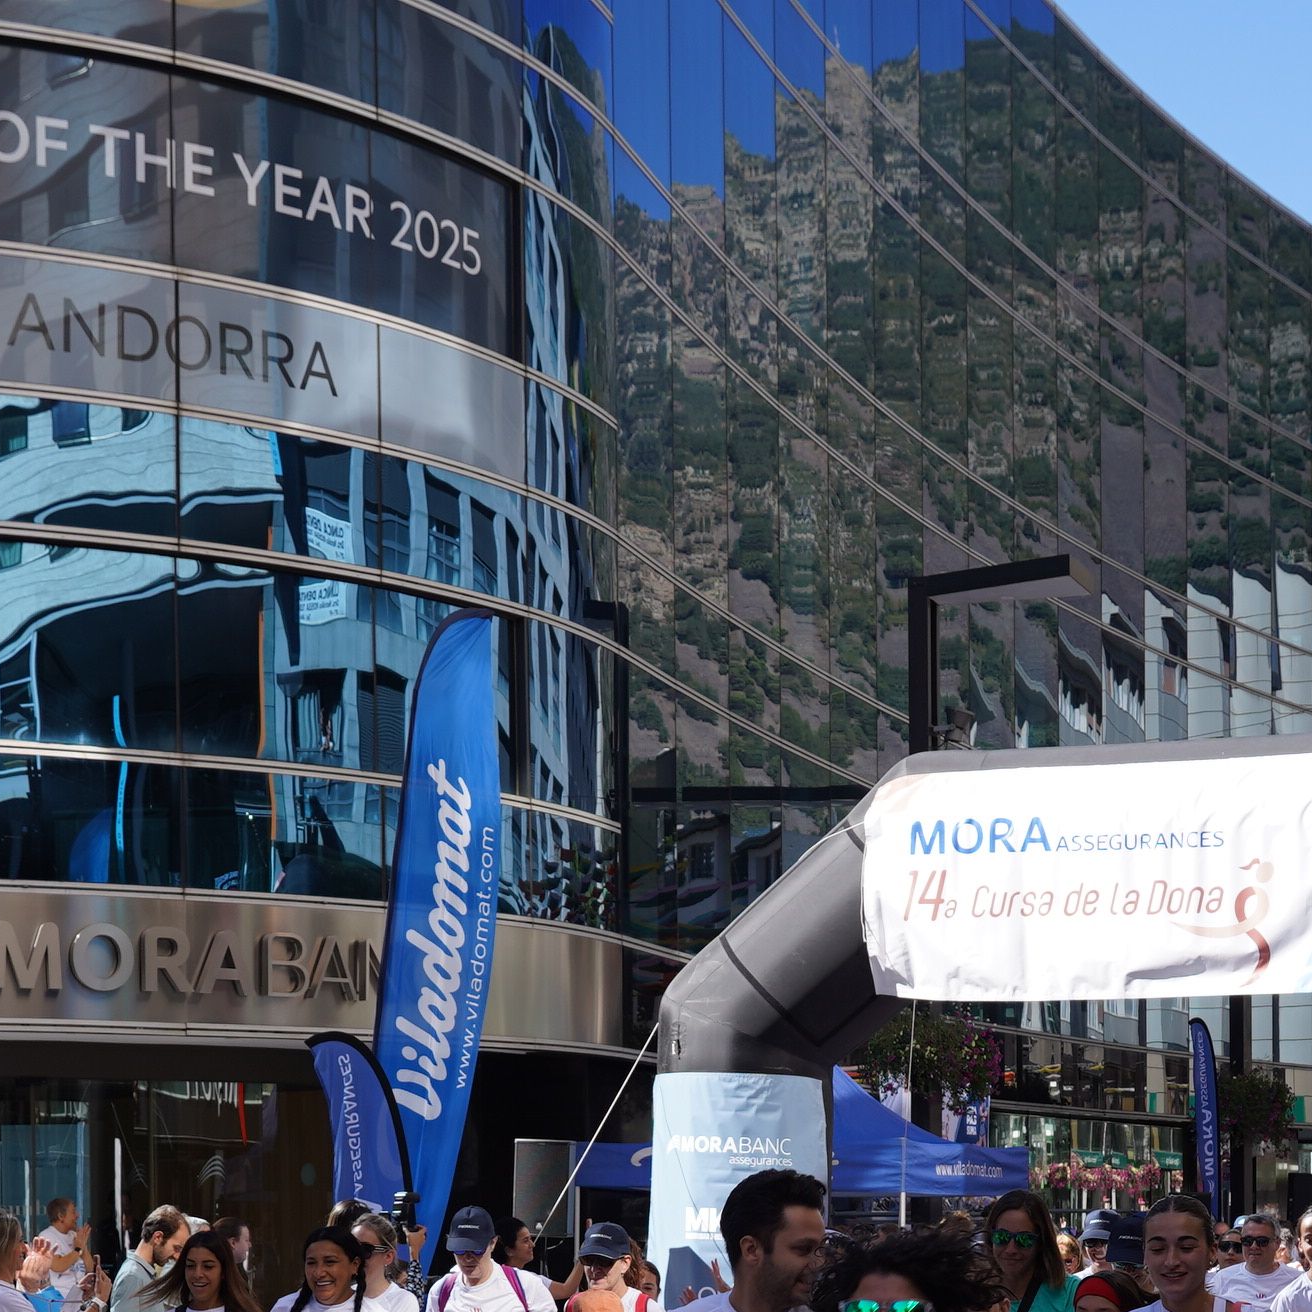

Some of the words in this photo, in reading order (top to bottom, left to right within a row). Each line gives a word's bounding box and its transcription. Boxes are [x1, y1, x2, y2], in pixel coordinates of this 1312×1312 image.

[88, 123, 216, 196] THE
[233, 153, 373, 240] YEAR
[389, 200, 482, 276] 2025
[7, 291, 338, 397] ANDORRA
[910, 817, 1051, 854] MORA
[1056, 831, 1224, 851] ASSEGURANCES
[903, 869, 957, 921] 14a
[972, 885, 1054, 918] Cursa
[1063, 883, 1099, 916] de
[1111, 883, 1140, 915] la
[1147, 880, 1224, 915] Dona
[394, 758, 470, 1122] Viladomat
[455, 825, 496, 1089] www.viladomat.com
[680, 1136, 792, 1156] MORABANC
[729, 1156, 793, 1167] assegurances
[936, 1161, 1003, 1178] www.viladomat.com
